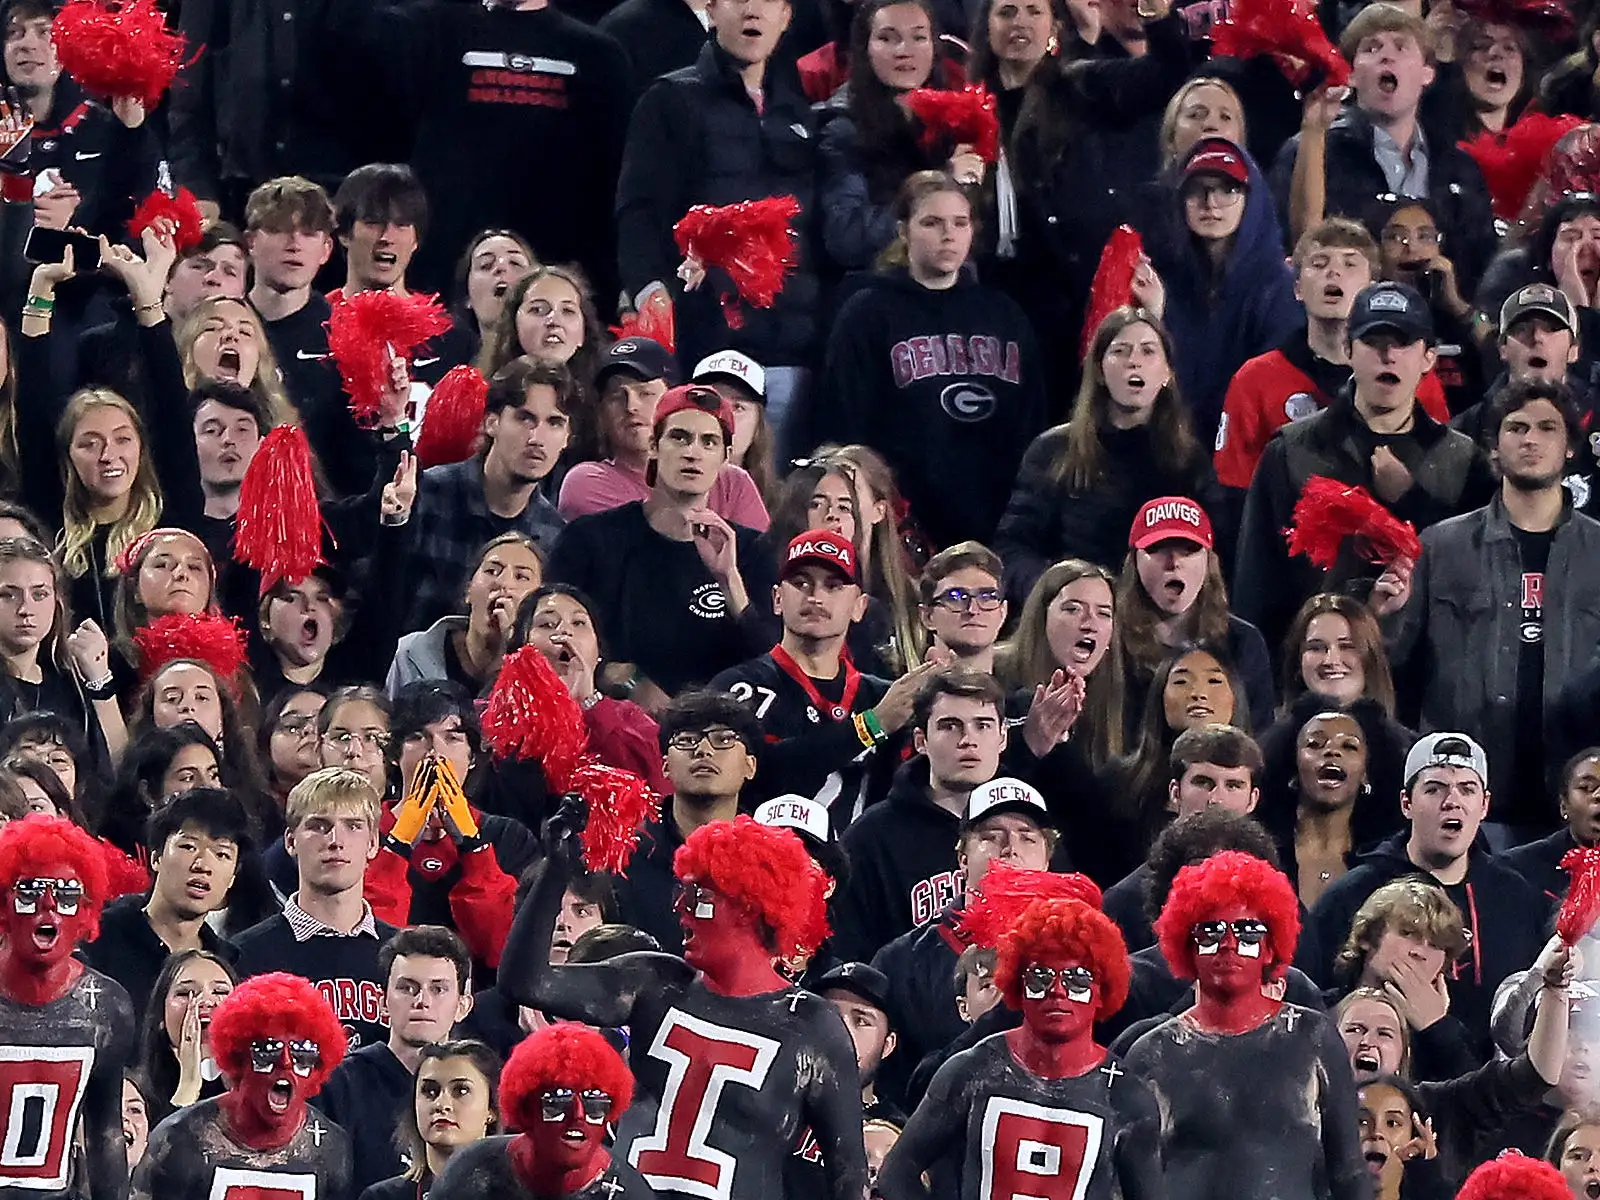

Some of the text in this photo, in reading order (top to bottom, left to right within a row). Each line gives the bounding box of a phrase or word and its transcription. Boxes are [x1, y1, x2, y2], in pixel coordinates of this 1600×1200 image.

[1145, 502, 1200, 527] DAWGS
[989, 787, 1031, 804] SIC 'EM
[766, 803, 809, 825] SIC 'EM
